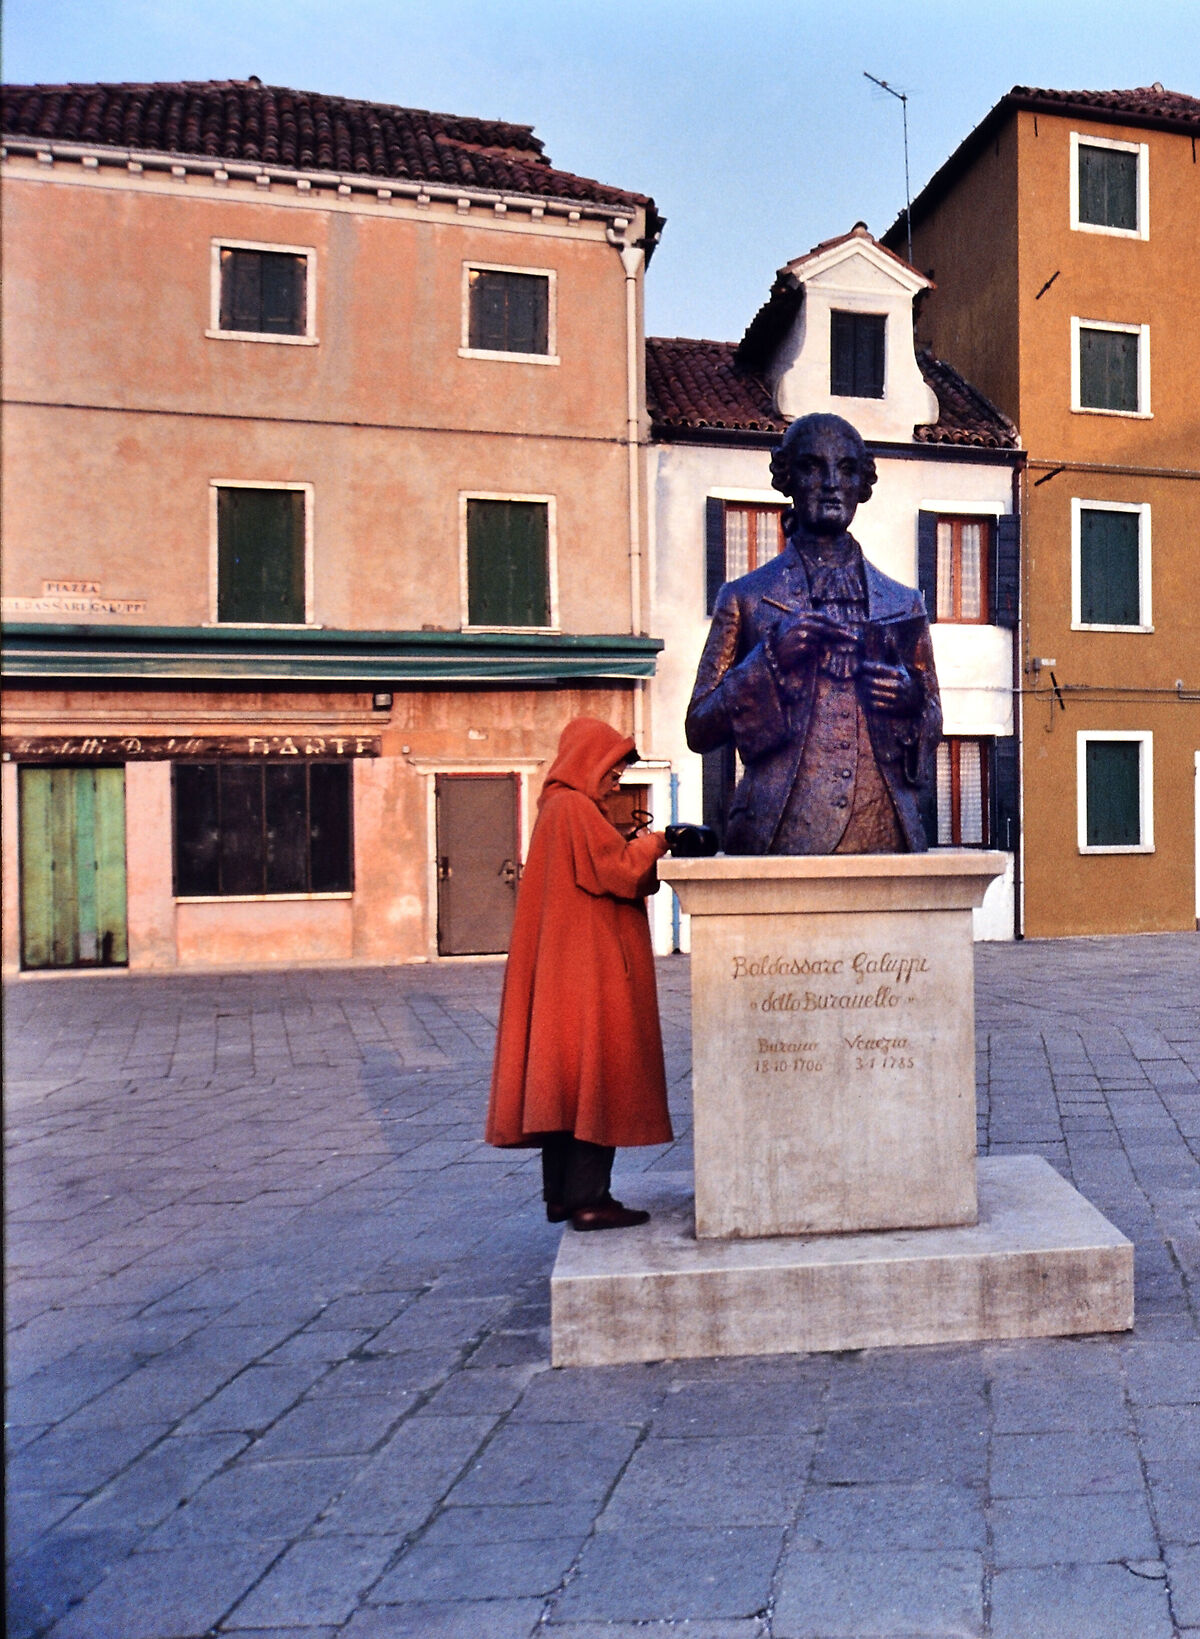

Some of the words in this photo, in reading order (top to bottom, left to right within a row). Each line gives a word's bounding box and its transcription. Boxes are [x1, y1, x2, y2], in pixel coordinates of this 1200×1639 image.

[47, 583, 98, 593] PIAZZA
[731, 955, 844, 980] Baldassare
[851, 952, 931, 985] Galuppi
